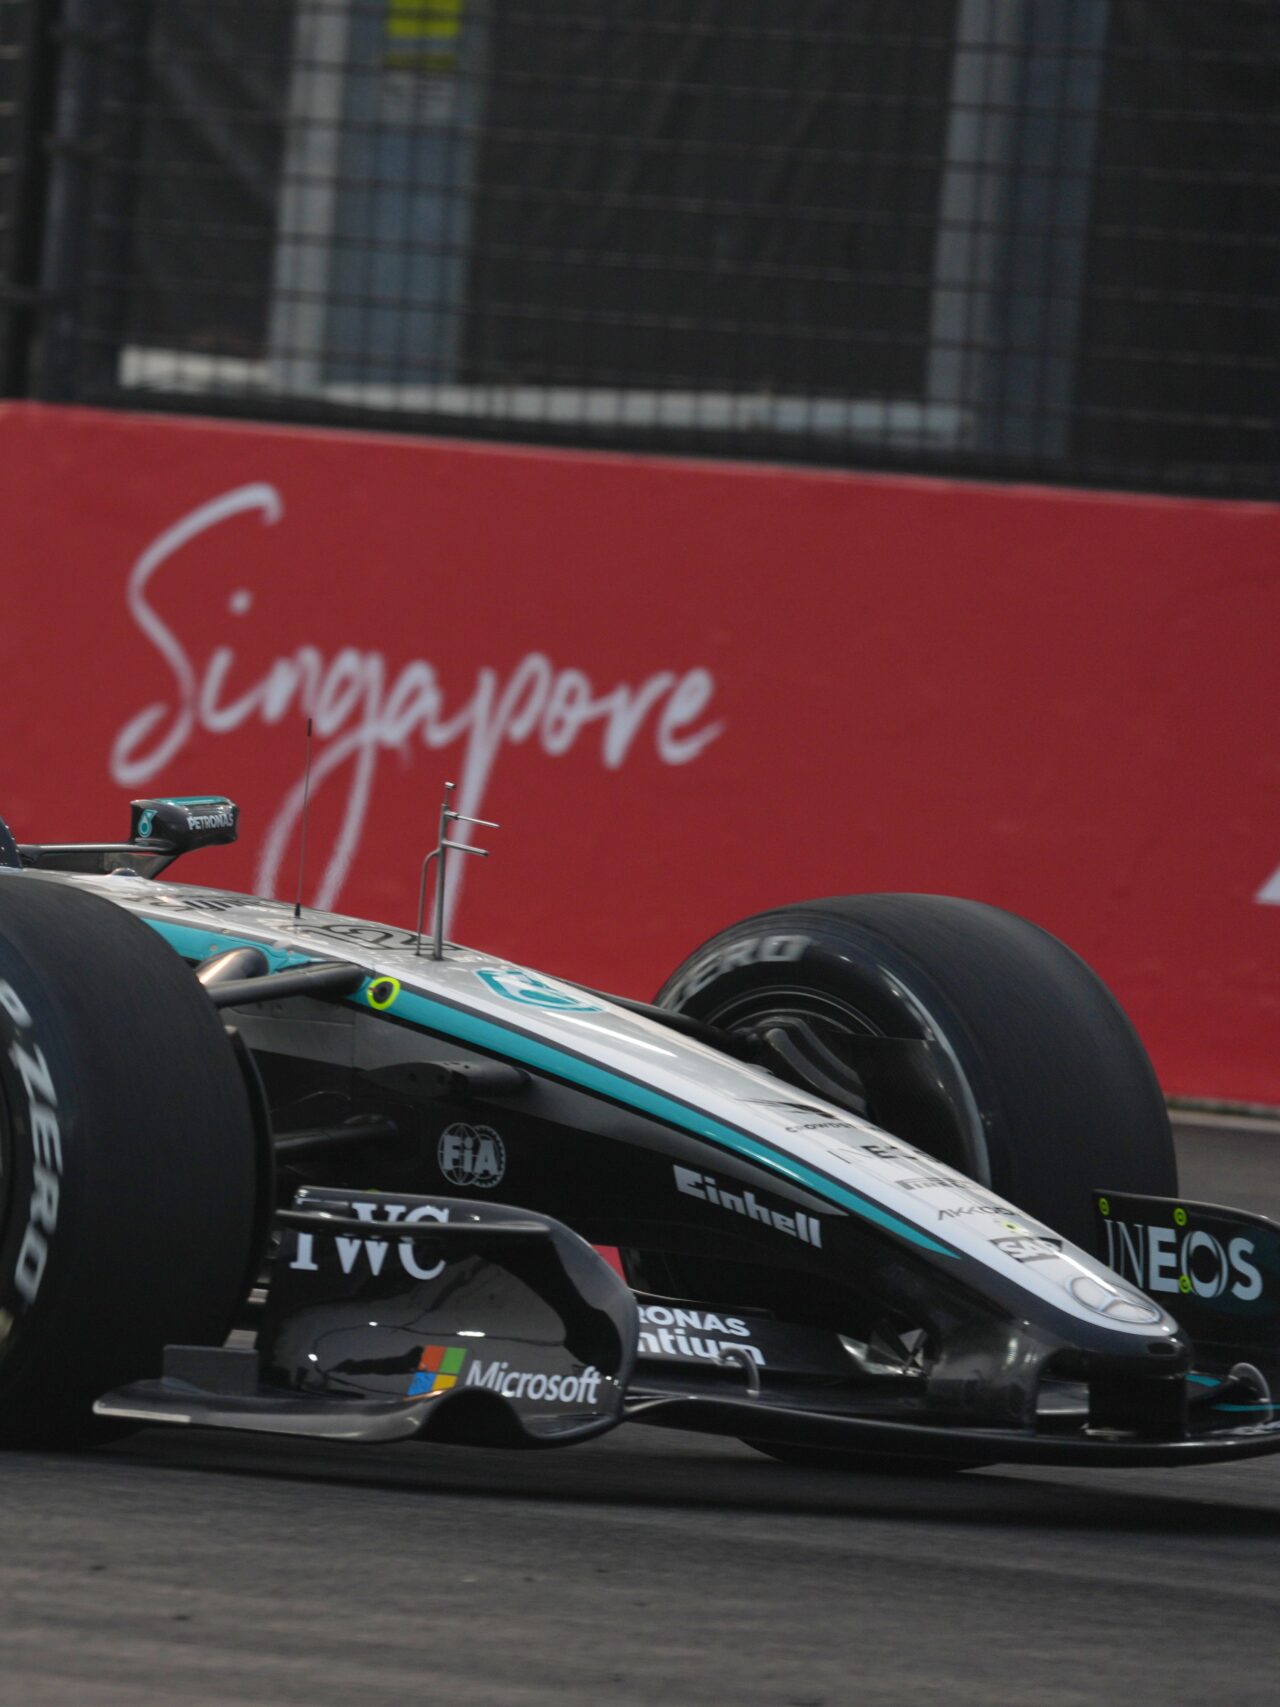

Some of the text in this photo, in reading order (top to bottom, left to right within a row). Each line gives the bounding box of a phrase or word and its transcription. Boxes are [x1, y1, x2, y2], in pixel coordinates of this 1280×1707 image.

[111, 481, 726, 938] Singapore
[187, 812, 235, 831] PETRONAS
[8, 1039, 64, 1305] ZERO
[673, 1164, 822, 1249] Einhell
[289, 1202, 451, 1281] IWC
[1104, 1219, 1263, 1301] INEOS
[465, 1359, 602, 1405] Microsoft
